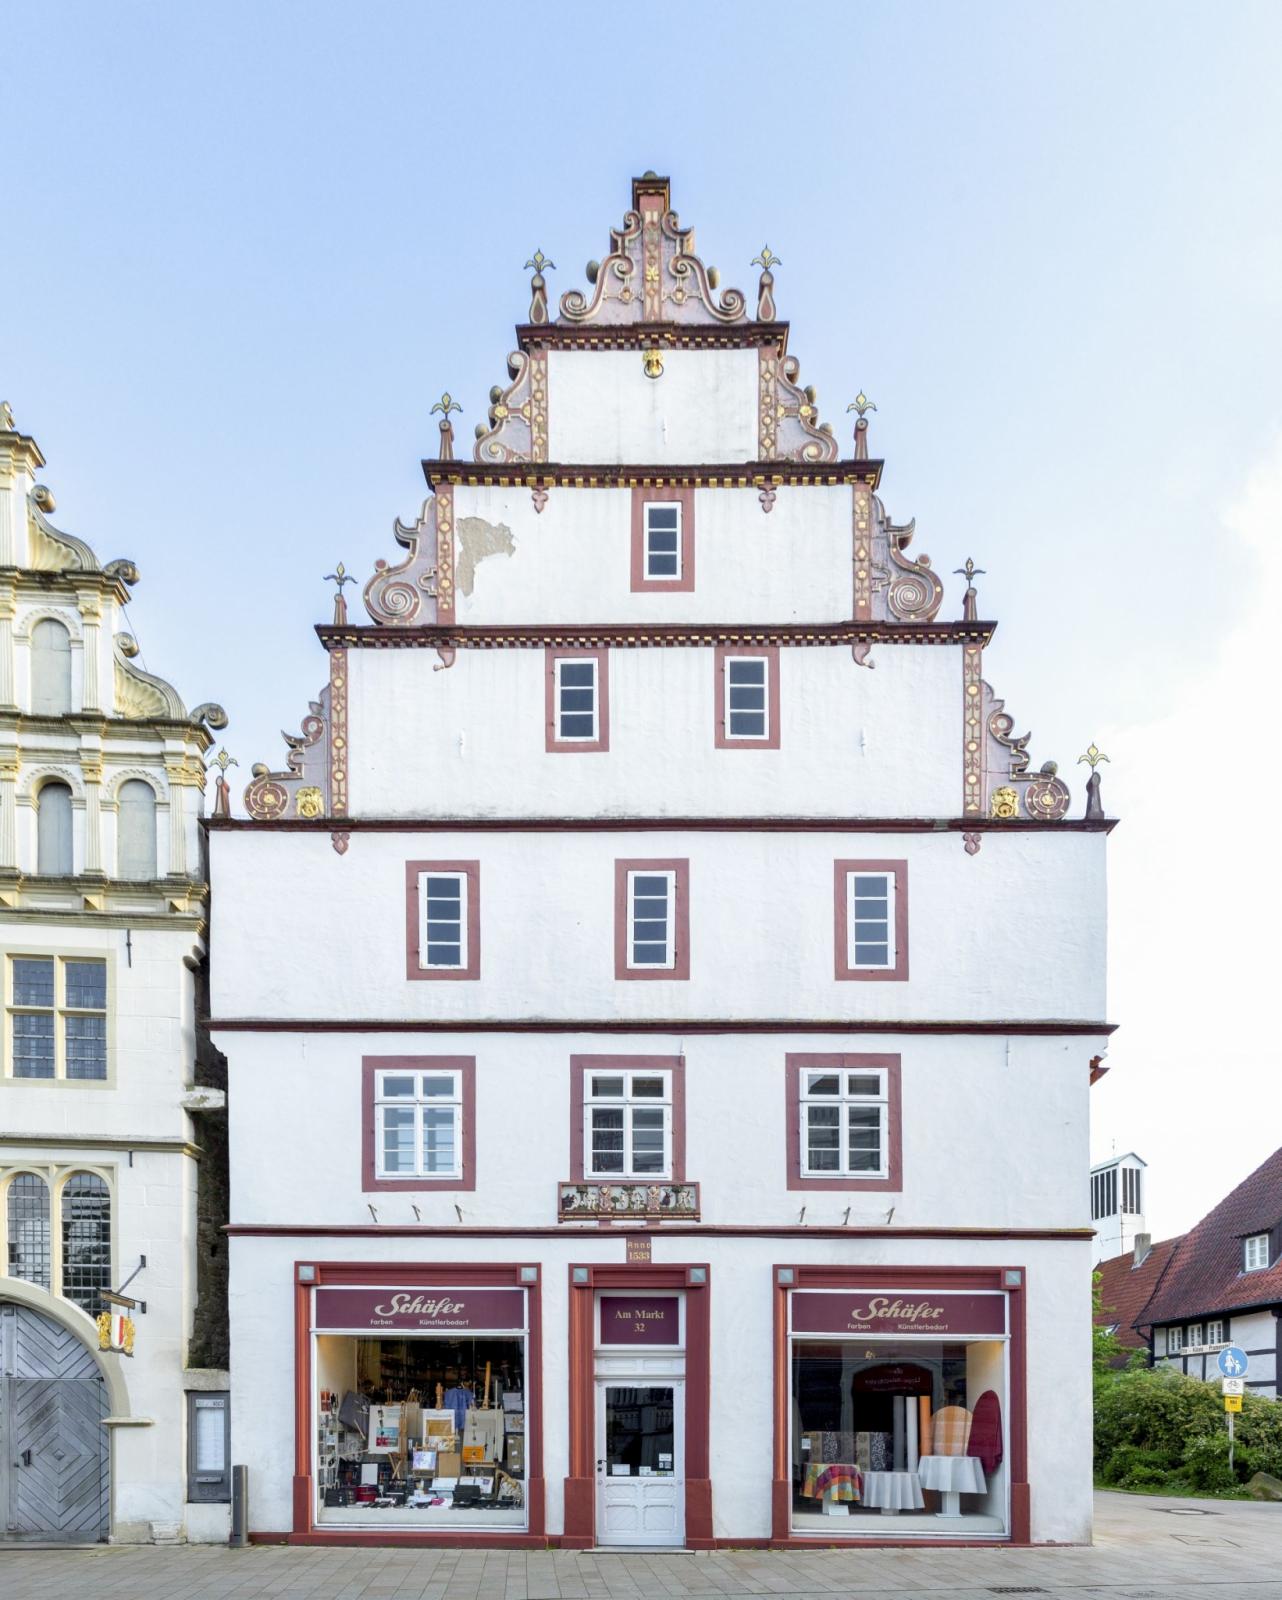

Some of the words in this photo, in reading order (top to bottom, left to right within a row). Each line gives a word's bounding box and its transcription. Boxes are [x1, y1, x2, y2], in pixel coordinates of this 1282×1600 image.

[374, 1293, 465, 1318] Schäfer
[851, 1297, 944, 1322] Schäfer
[615, 1310, 631, 1319] Am
[635, 1309, 664, 1319] Markt
[419, 1319, 469, 1327] Künstlerbedarf
[635, 1323, 645, 1332] 32
[897, 1323, 948, 1331] Künstlerbedarf
